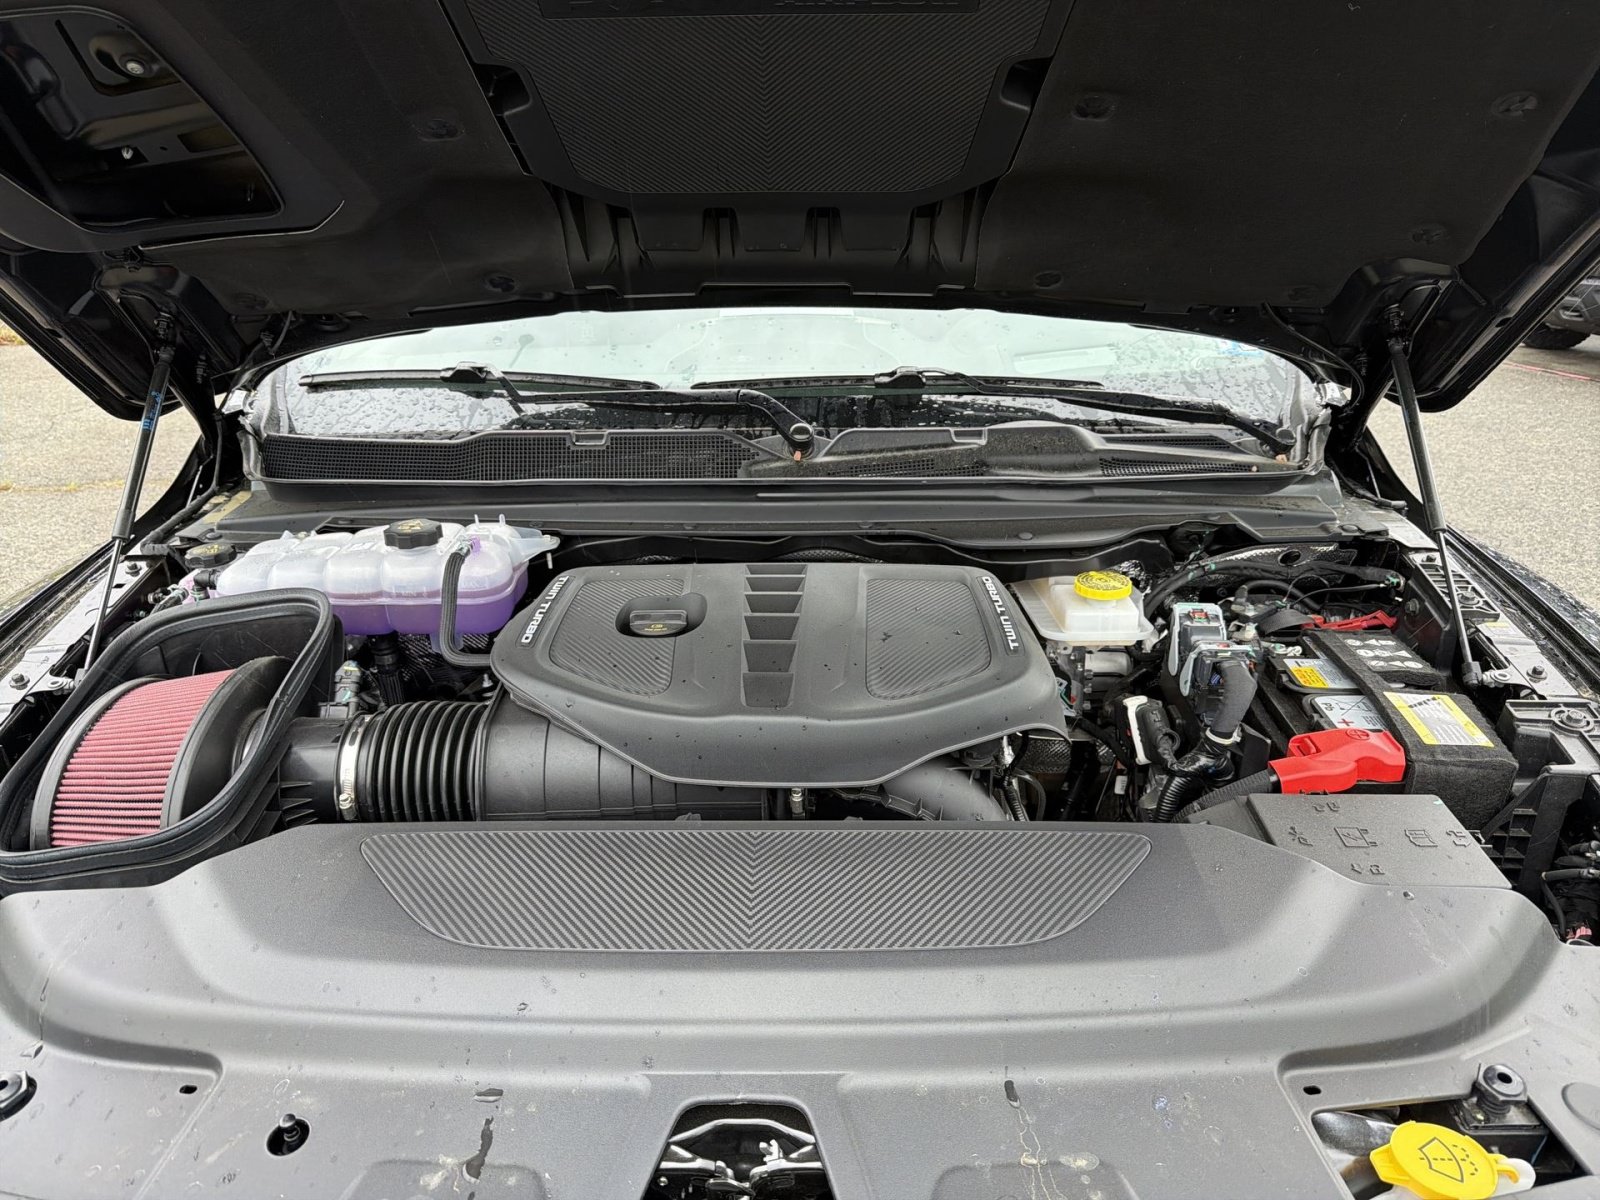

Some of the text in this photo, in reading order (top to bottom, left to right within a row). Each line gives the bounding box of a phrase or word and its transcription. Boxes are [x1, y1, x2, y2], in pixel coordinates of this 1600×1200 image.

[521, 576, 569, 643] TWIN TURBO
[982, 576, 1019, 650] TWIN TURBO
